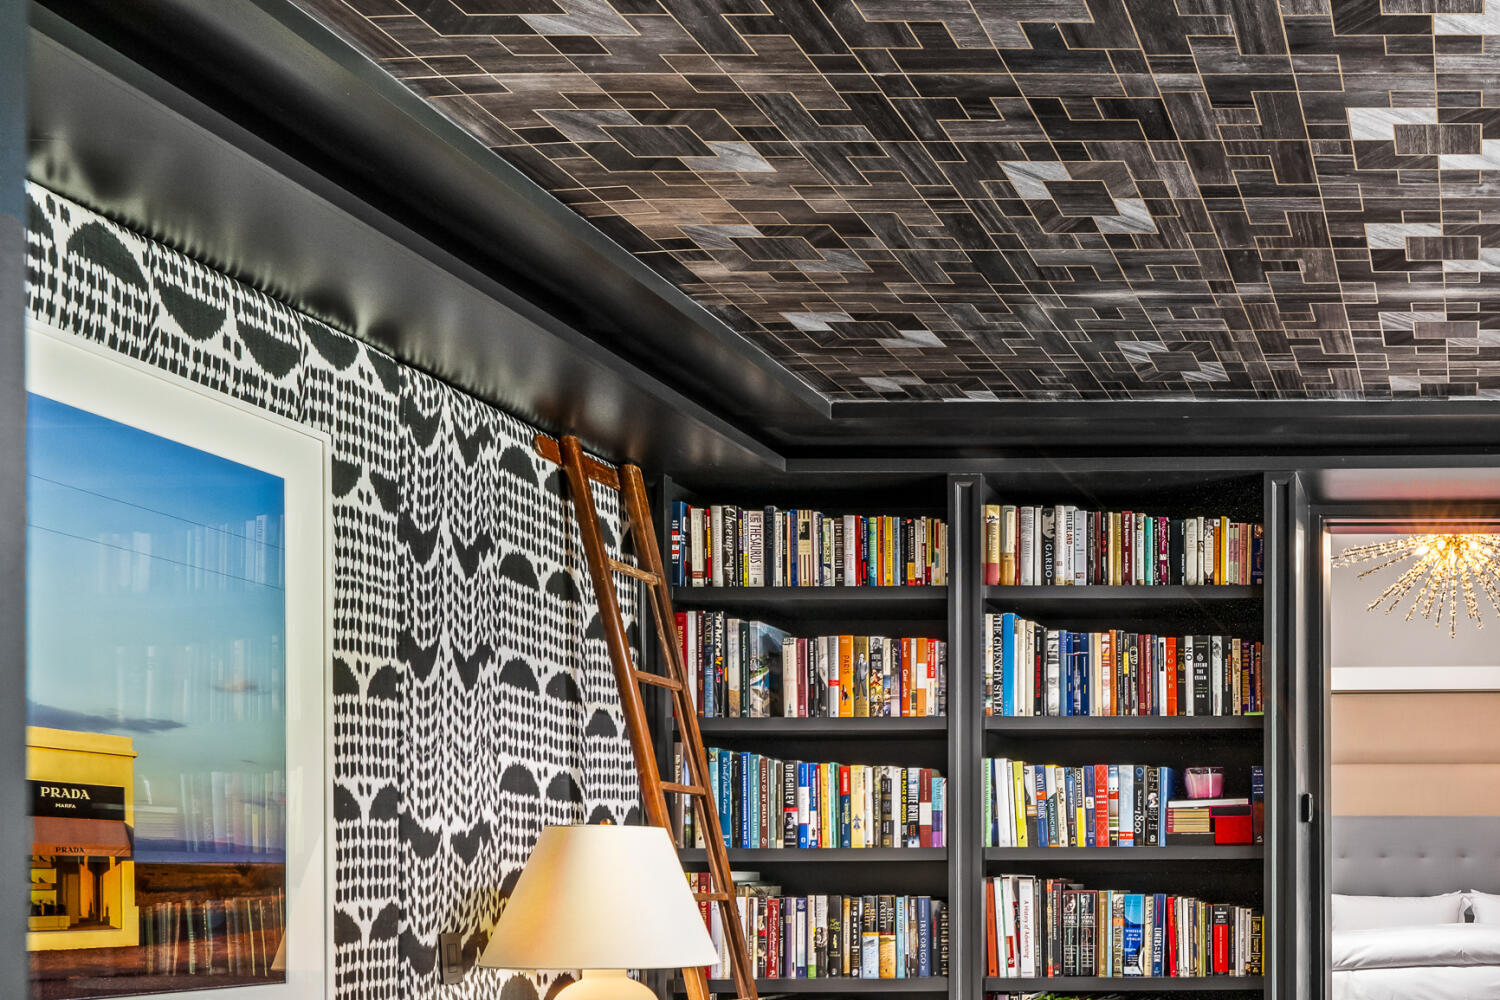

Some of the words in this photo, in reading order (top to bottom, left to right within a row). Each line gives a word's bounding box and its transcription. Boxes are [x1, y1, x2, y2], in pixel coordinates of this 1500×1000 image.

[750, 524, 762, 564] THESAURUS
[1045, 543, 1053, 578] GARBO
[993, 617, 1001, 635] THE
[993, 637, 1002, 682] GIVENCHY
[1185, 646, 1193, 661] NO
[842, 654, 850, 674] PARIS
[993, 684, 1002, 713] STYLE
[761, 782, 767, 792] OF
[785, 764, 795, 805] DIAGHILEV
[1036, 773, 1044, 791] SOCIAL
[40, 786, 91, 801] PRADA
[761, 794, 767, 802] MY
[901, 795, 907, 803] OF
[908, 787, 920, 804] WHITE
[908, 804, 920, 823] DEVIL
[1037, 799, 1046, 819] CRIMES
[1047, 798, 1056, 835] ROMANCING
[1134, 810, 1144, 834] 1800
[879, 900, 887, 930] FOLLETT
[886, 907, 894, 922] KEN
[1023, 931, 1031, 959] Advertising
[1114, 927, 1122, 972] VENICE
